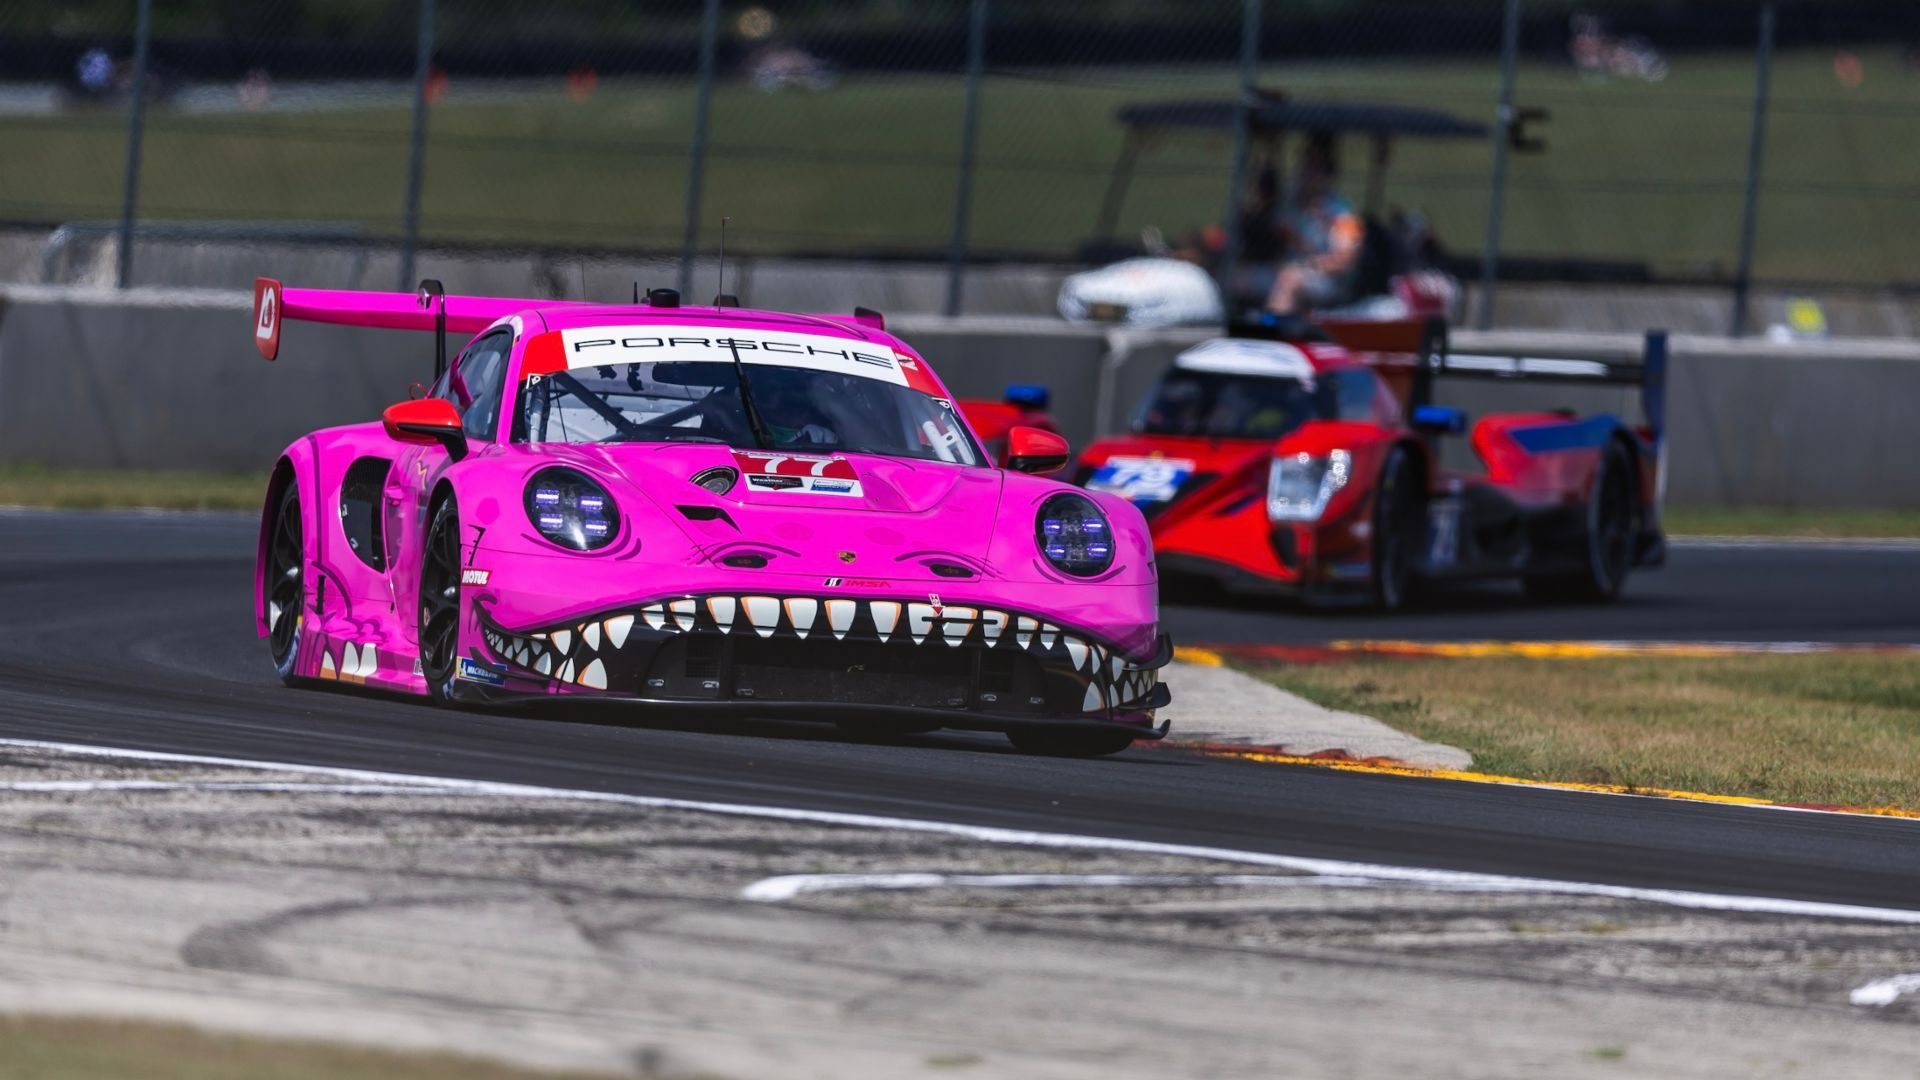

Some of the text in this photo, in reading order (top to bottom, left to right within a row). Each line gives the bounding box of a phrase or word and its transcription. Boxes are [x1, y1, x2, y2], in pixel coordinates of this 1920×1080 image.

[574, 337, 894, 369] PORSCHE
[747, 455, 834, 476] 77
[462, 569, 490, 585] MOTUL
[844, 580, 892, 589] IMSA
